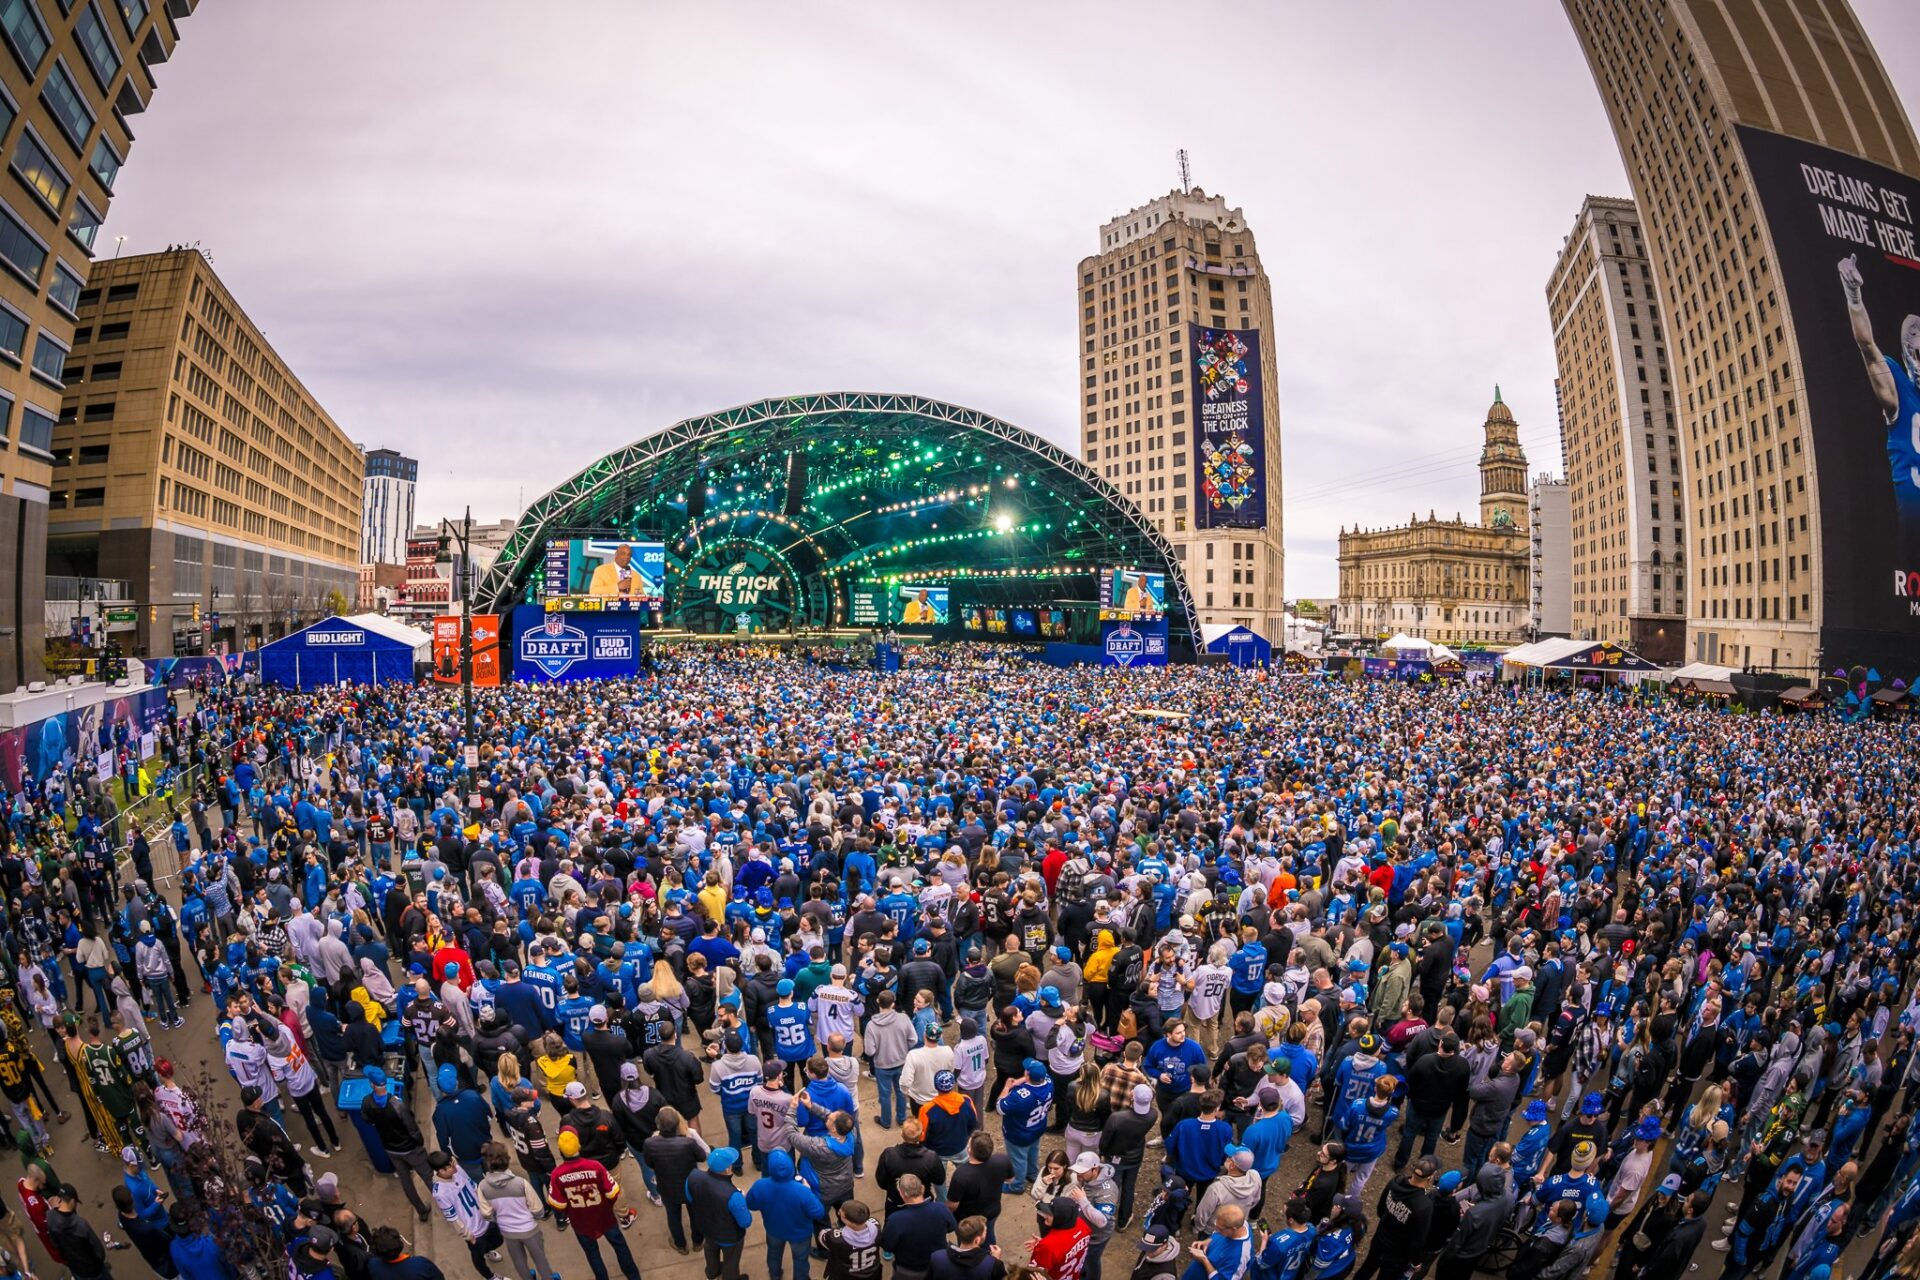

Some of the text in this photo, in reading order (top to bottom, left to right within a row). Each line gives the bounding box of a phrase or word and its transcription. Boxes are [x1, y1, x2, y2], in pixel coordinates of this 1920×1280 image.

[1800, 163, 1913, 224] DREAMS GET
[1818, 203, 1920, 262] MADE HERE
[1202, 400, 1247, 415] GREATNESS
[1202, 417, 1248, 433] THE CLOCK
[699, 575, 780, 590] THE PICK
[715, 590, 759, 604] IS IN
[547, 623, 562, 633] NFL
[308, 633, 363, 643] BUD LIGHT
[600, 639, 624, 647] BUD
[1109, 642, 1140, 650] DRAFT
[527, 643, 582, 654] DRAFT
[595, 647, 629, 657] LIGHT
[1591, 651, 1605, 665] VIP
[371, 826, 385, 838] 75
[100, 841, 108, 853] 11
[899, 855, 907, 868] 9
[891, 909, 907, 926] 97
[987, 904, 998, 922] 3
[528, 971, 555, 984] SANDERS
[1247, 962, 1263, 980] 97
[820, 992, 849, 1003] HARBAUGH
[1204, 983, 1224, 998] 20
[828, 1004, 838, 1020] 4
[780, 1016, 795, 1025] GIBBS
[412, 1019, 439, 1043] 24
[775, 1024, 805, 1046] 26
[127, 1047, 149, 1074] 84
[972, 1054, 982, 1072] 11
[0, 1060, 21, 1087] 90
[95, 1067, 115, 1086] 34
[1345, 1079, 1371, 1099] 20
[761, 1111, 774, 1129] 3
[510, 1125, 529, 1155] 95
[1355, 1123, 1377, 1143] 14
[559, 1170, 597, 1183] WASHINGTON
[457, 1184, 479, 1218] 14
[564, 1183, 602, 1208] 53
[1562, 1189, 1580, 1198] GIBBS
[849, 1245, 878, 1273] 16
